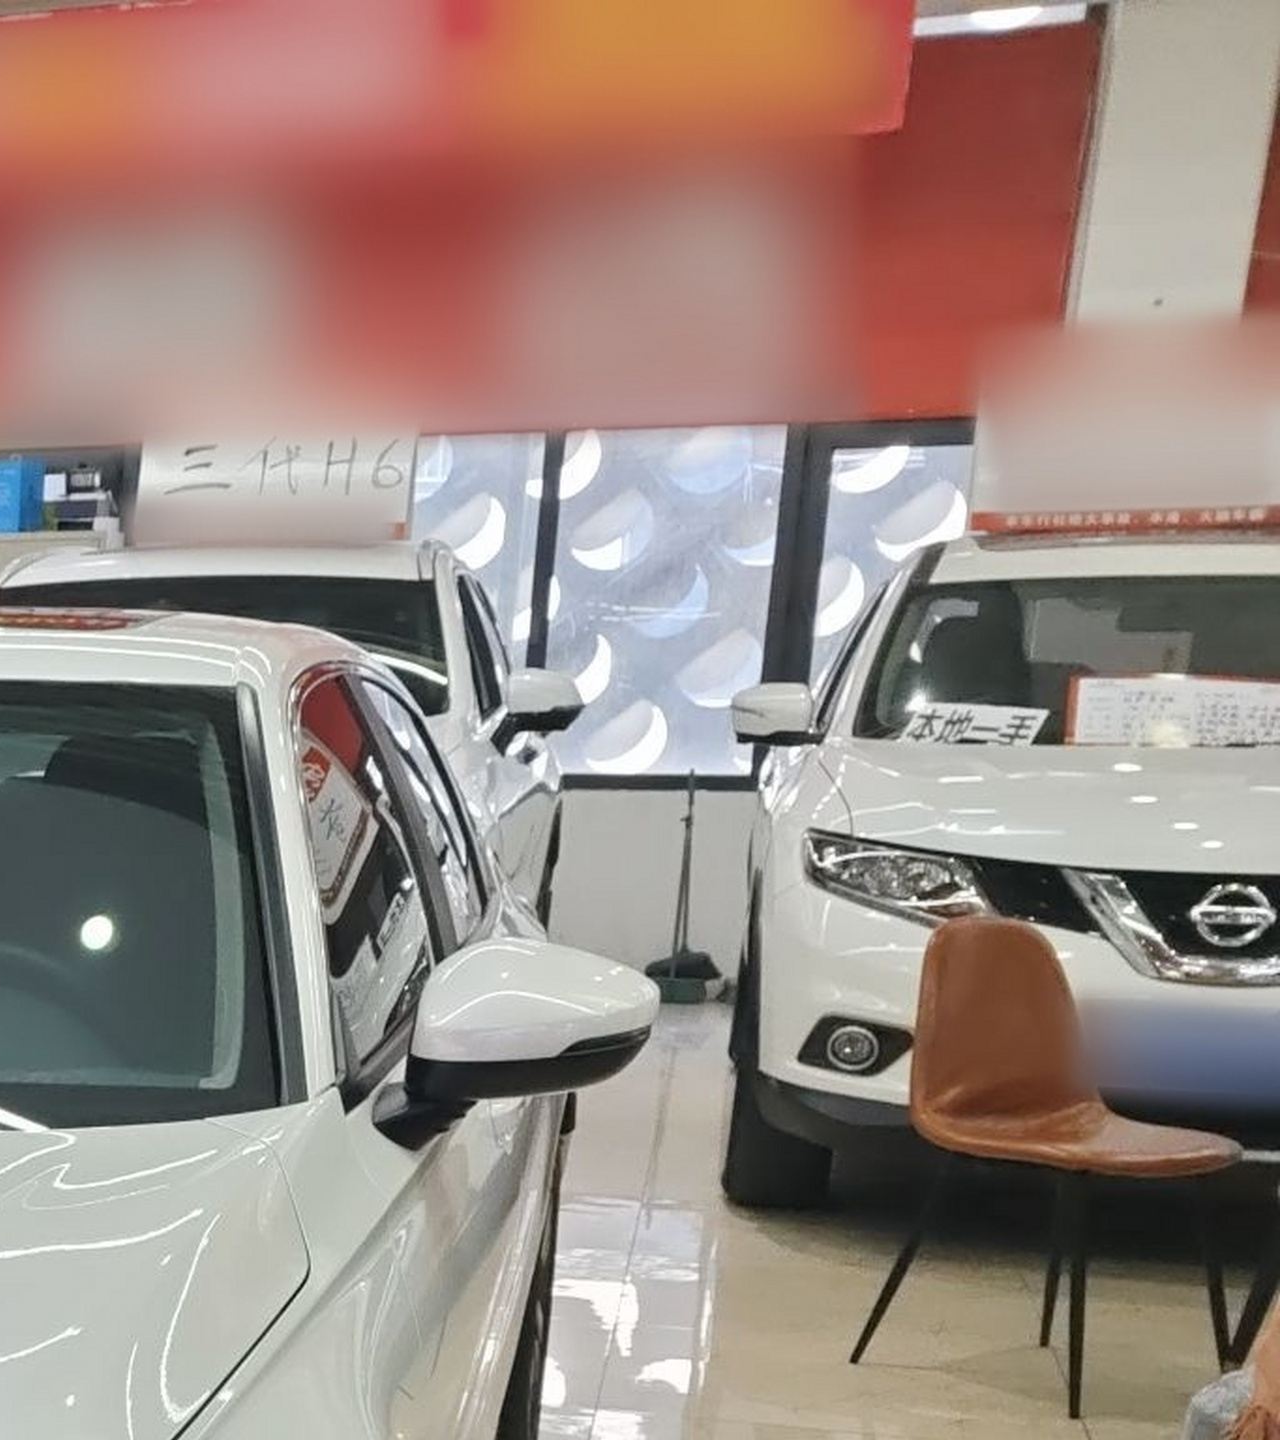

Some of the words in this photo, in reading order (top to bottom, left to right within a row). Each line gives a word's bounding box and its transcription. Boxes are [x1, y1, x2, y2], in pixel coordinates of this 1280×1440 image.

[162, 434, 404, 496] 三代H6
[905, 709, 1038, 745] 本地一手
